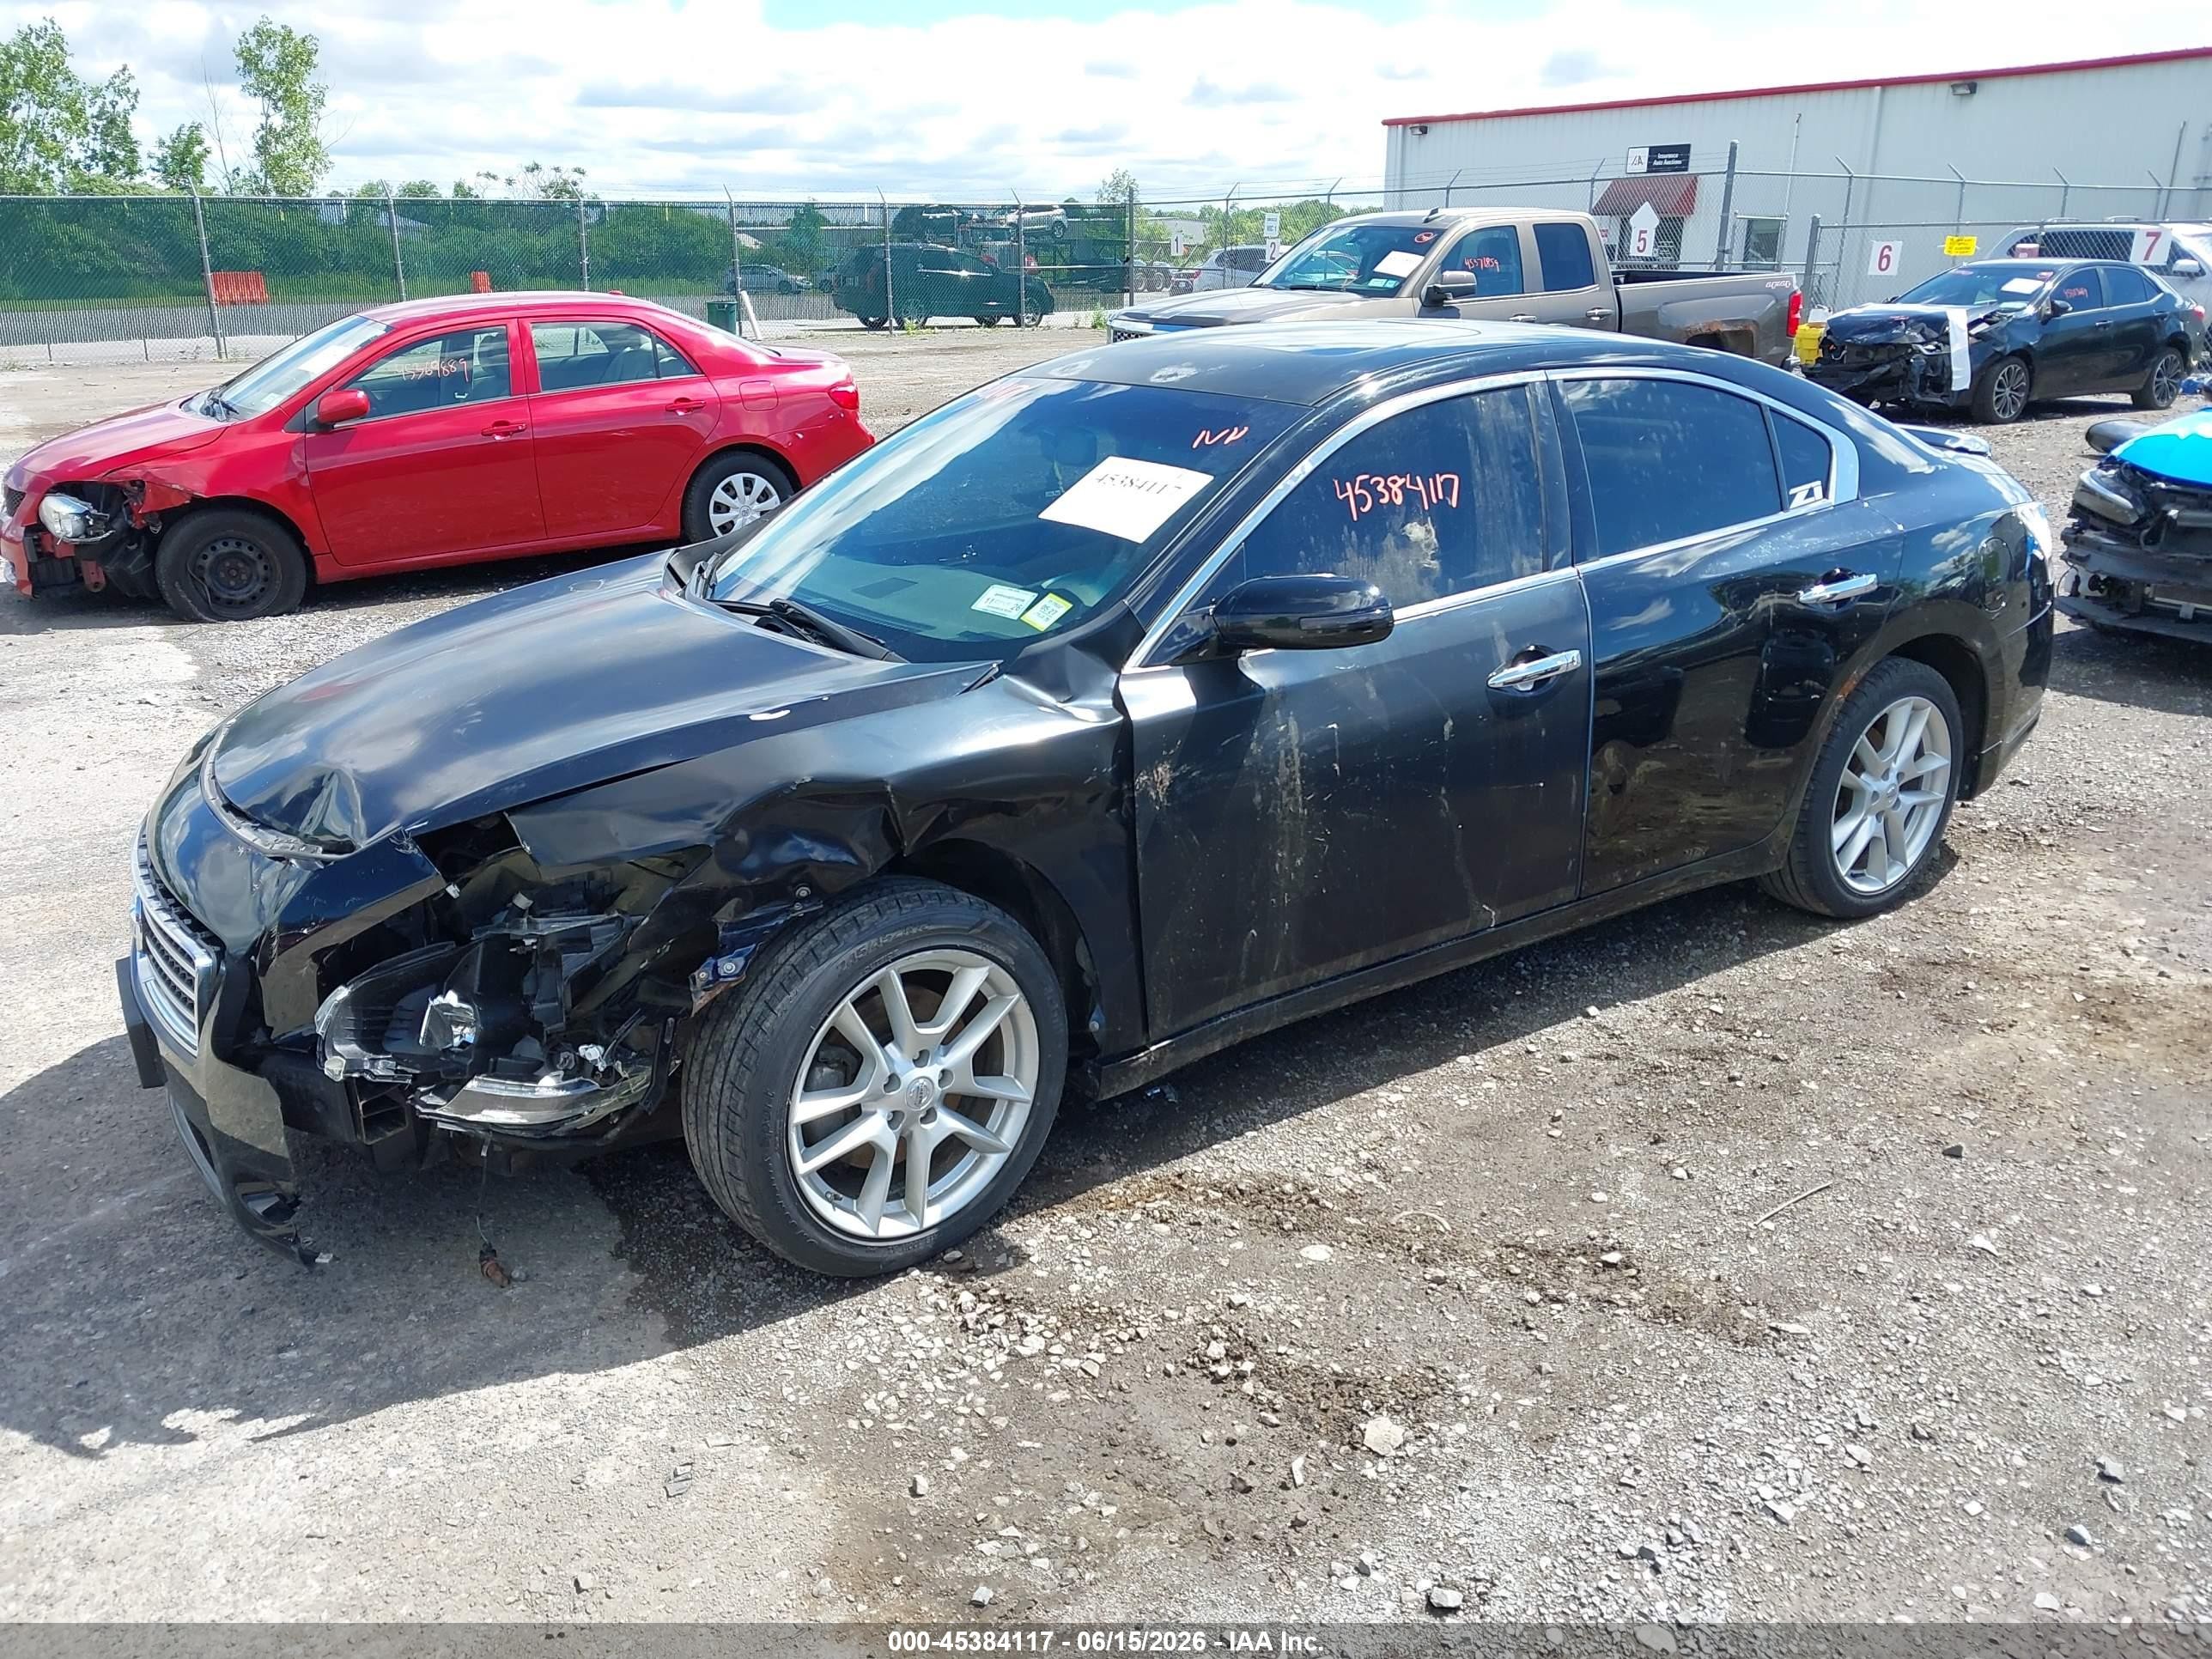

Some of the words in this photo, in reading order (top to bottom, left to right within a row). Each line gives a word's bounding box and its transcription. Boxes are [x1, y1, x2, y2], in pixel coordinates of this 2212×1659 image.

[1174, 235, 1180, 253] 1
[1269, 241, 1277, 260] 2
[1637, 229, 1648, 253] 5
[2143, 231, 2162, 261] 7
[1878, 245, 1893, 271] 6
[1333, 473, 1460, 522] 45384117
